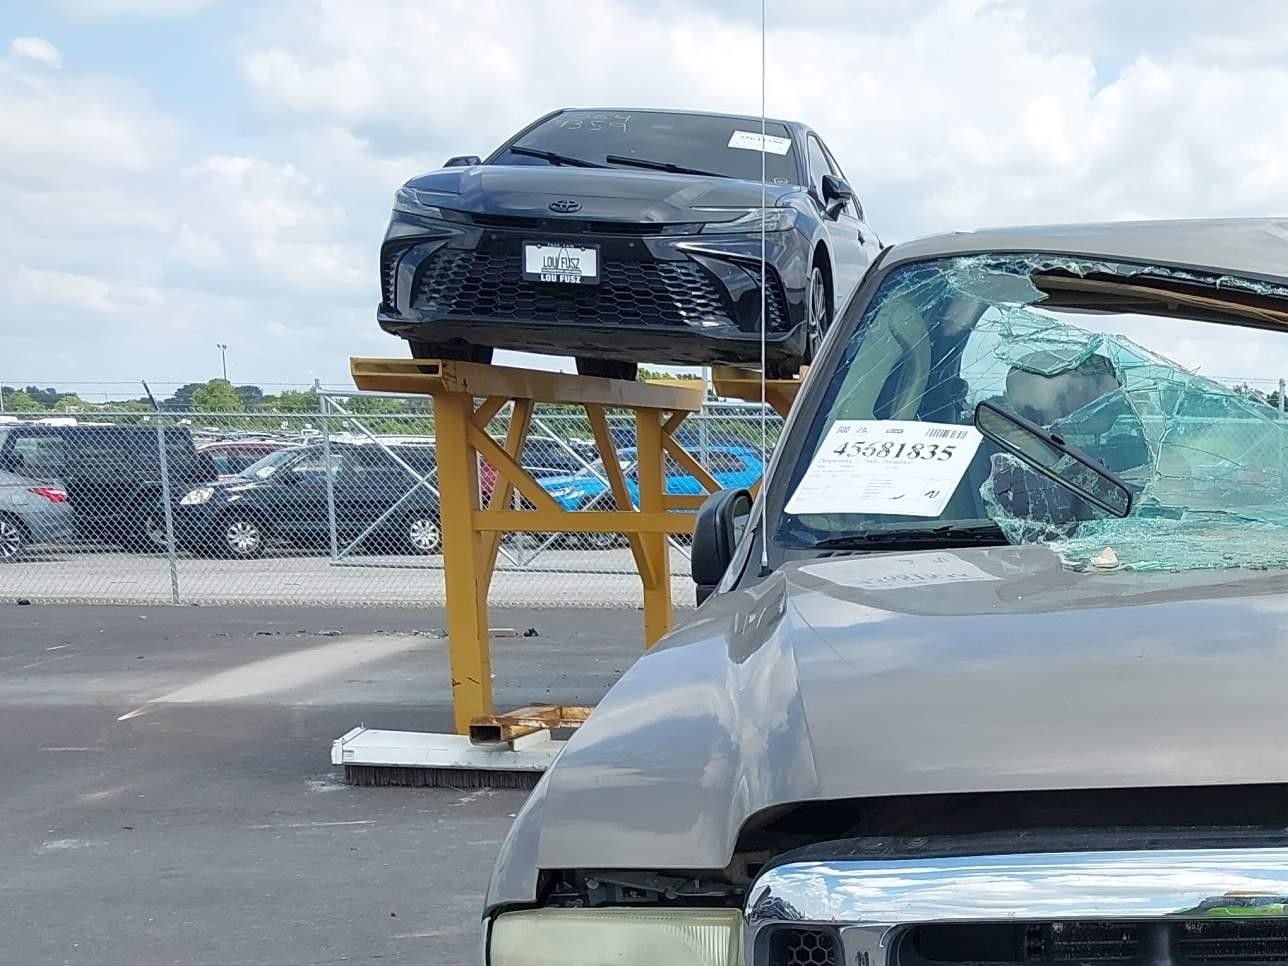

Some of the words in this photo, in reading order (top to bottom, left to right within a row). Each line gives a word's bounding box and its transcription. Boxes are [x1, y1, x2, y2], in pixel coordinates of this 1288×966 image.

[543, 255, 559, 268] LOU
[561, 257, 580, 269] FUSZ
[540, 274, 557, 282] LOU
[559, 275, 582, 284] FUSZ
[833, 440, 957, 462] 45681835
